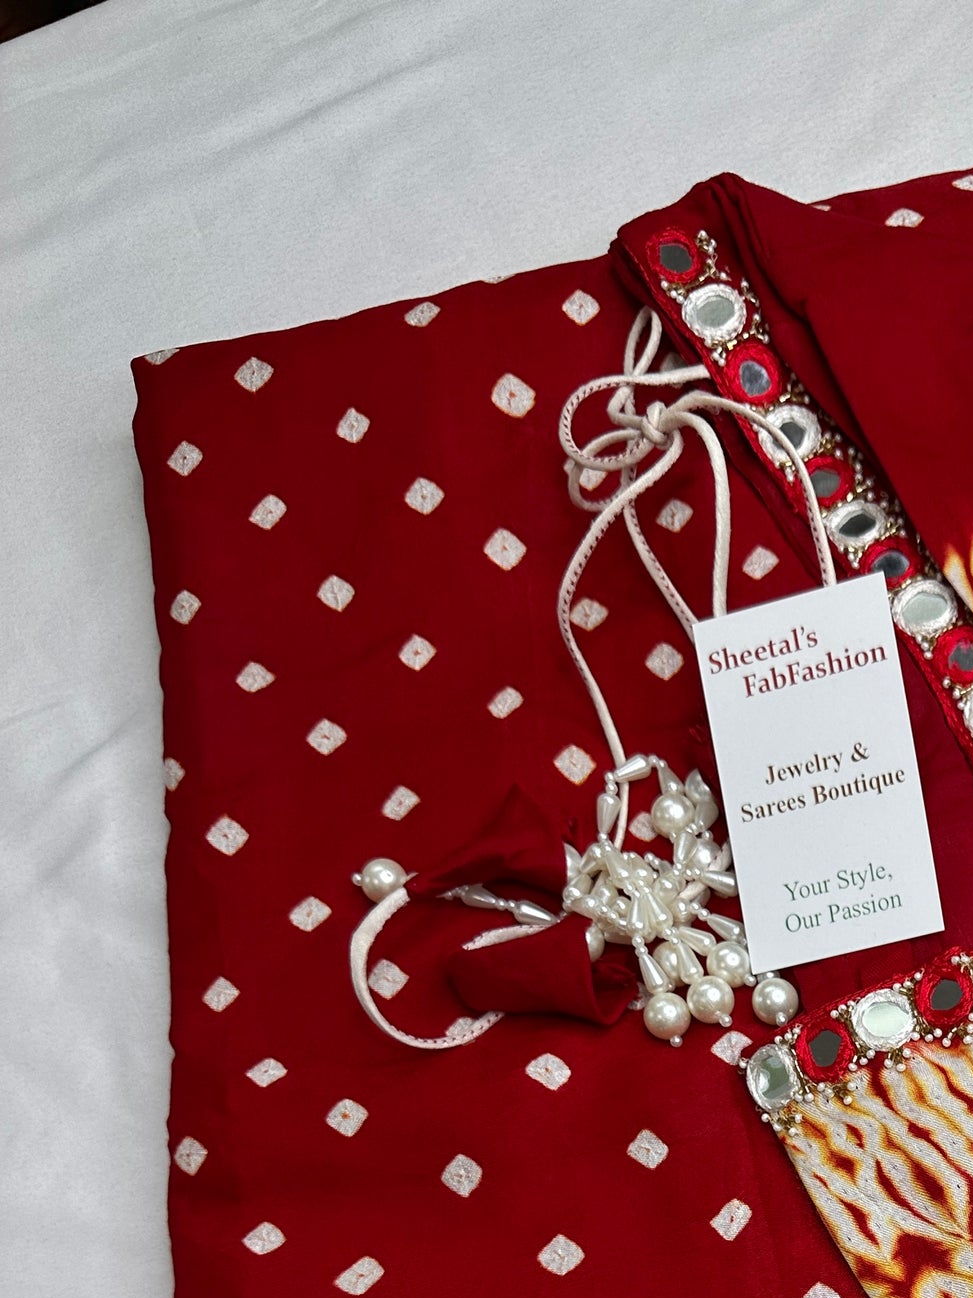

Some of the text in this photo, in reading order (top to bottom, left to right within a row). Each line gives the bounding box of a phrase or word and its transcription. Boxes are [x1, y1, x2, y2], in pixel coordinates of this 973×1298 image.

[708, 626, 818, 675] Sheetal's
[742, 645, 888, 698] FabFashion
[764, 741, 870, 786] Jewelry &
[740, 766, 906, 823] Sarees Boutique
[783, 862, 894, 902] Your Style,
[785, 892, 903, 934] Our Passion
